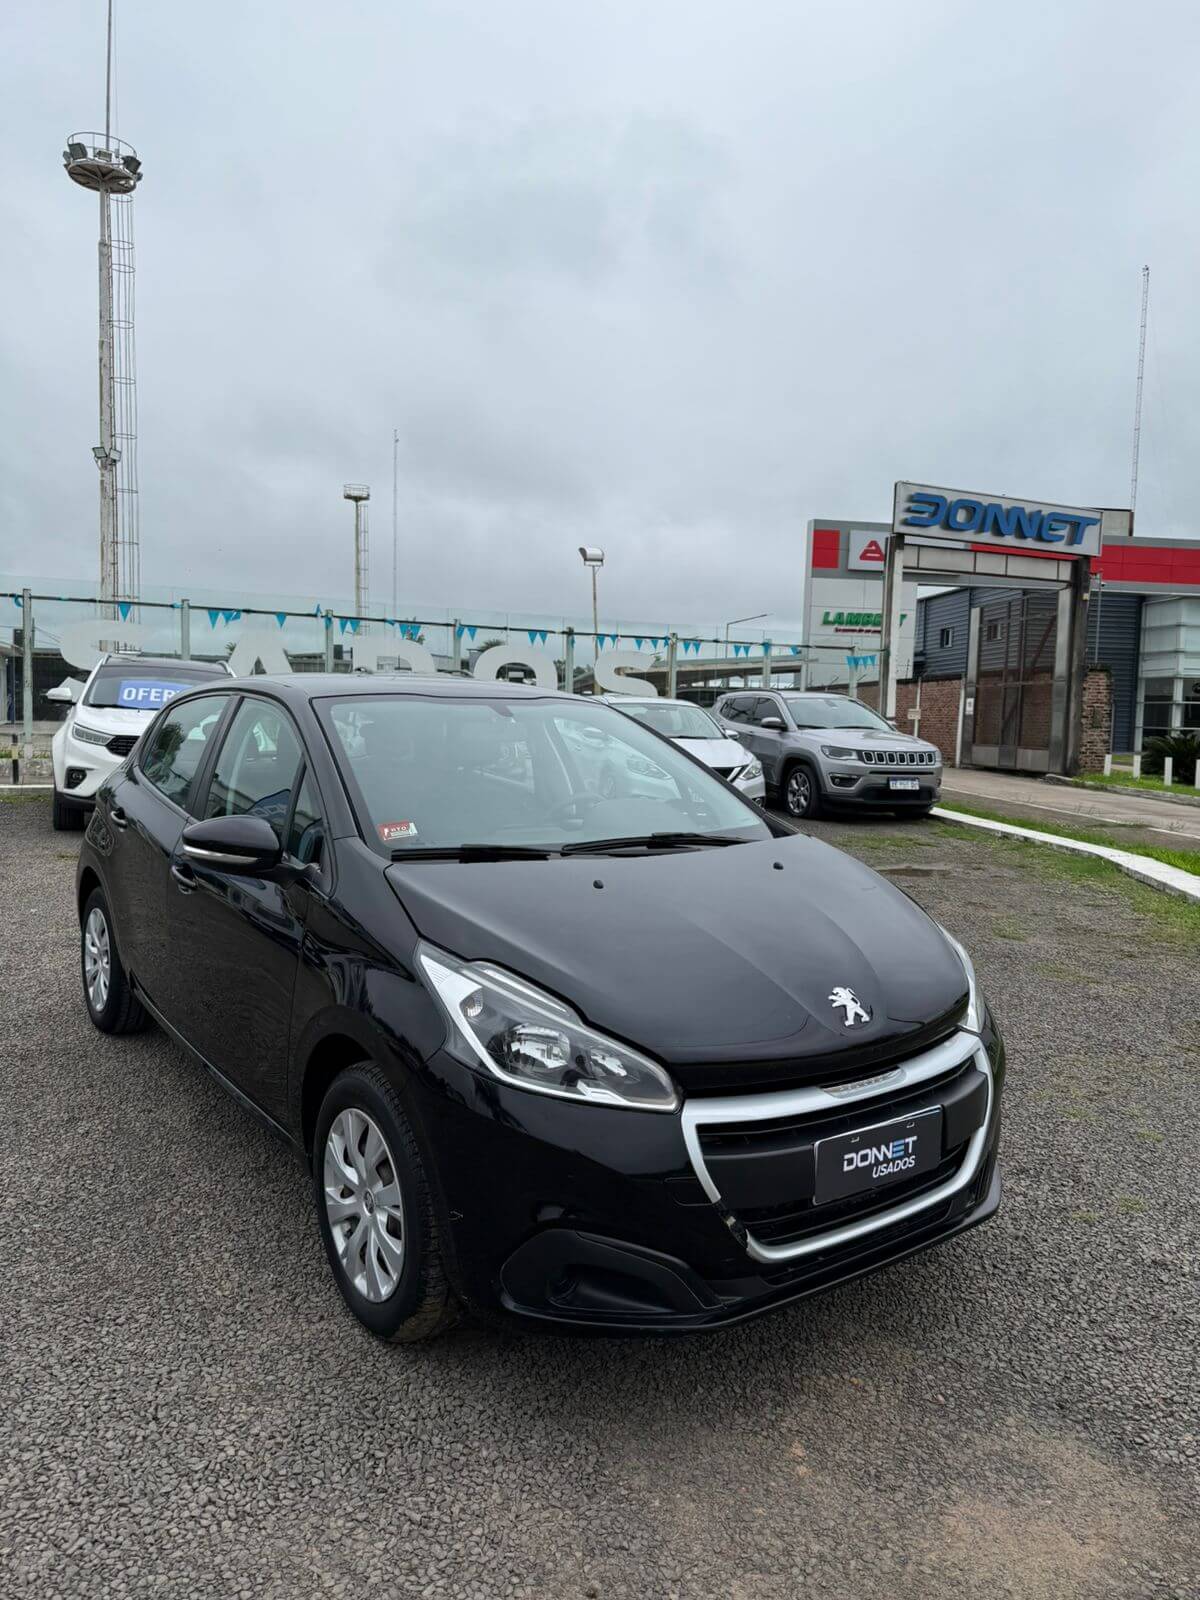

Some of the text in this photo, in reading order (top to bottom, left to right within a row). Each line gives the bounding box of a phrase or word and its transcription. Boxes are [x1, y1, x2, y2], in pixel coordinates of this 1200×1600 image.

[905, 491, 1101, 545] DONNET
[842, 1135, 918, 1172] DONNET
[872, 1155, 916, 1178] USADOS
